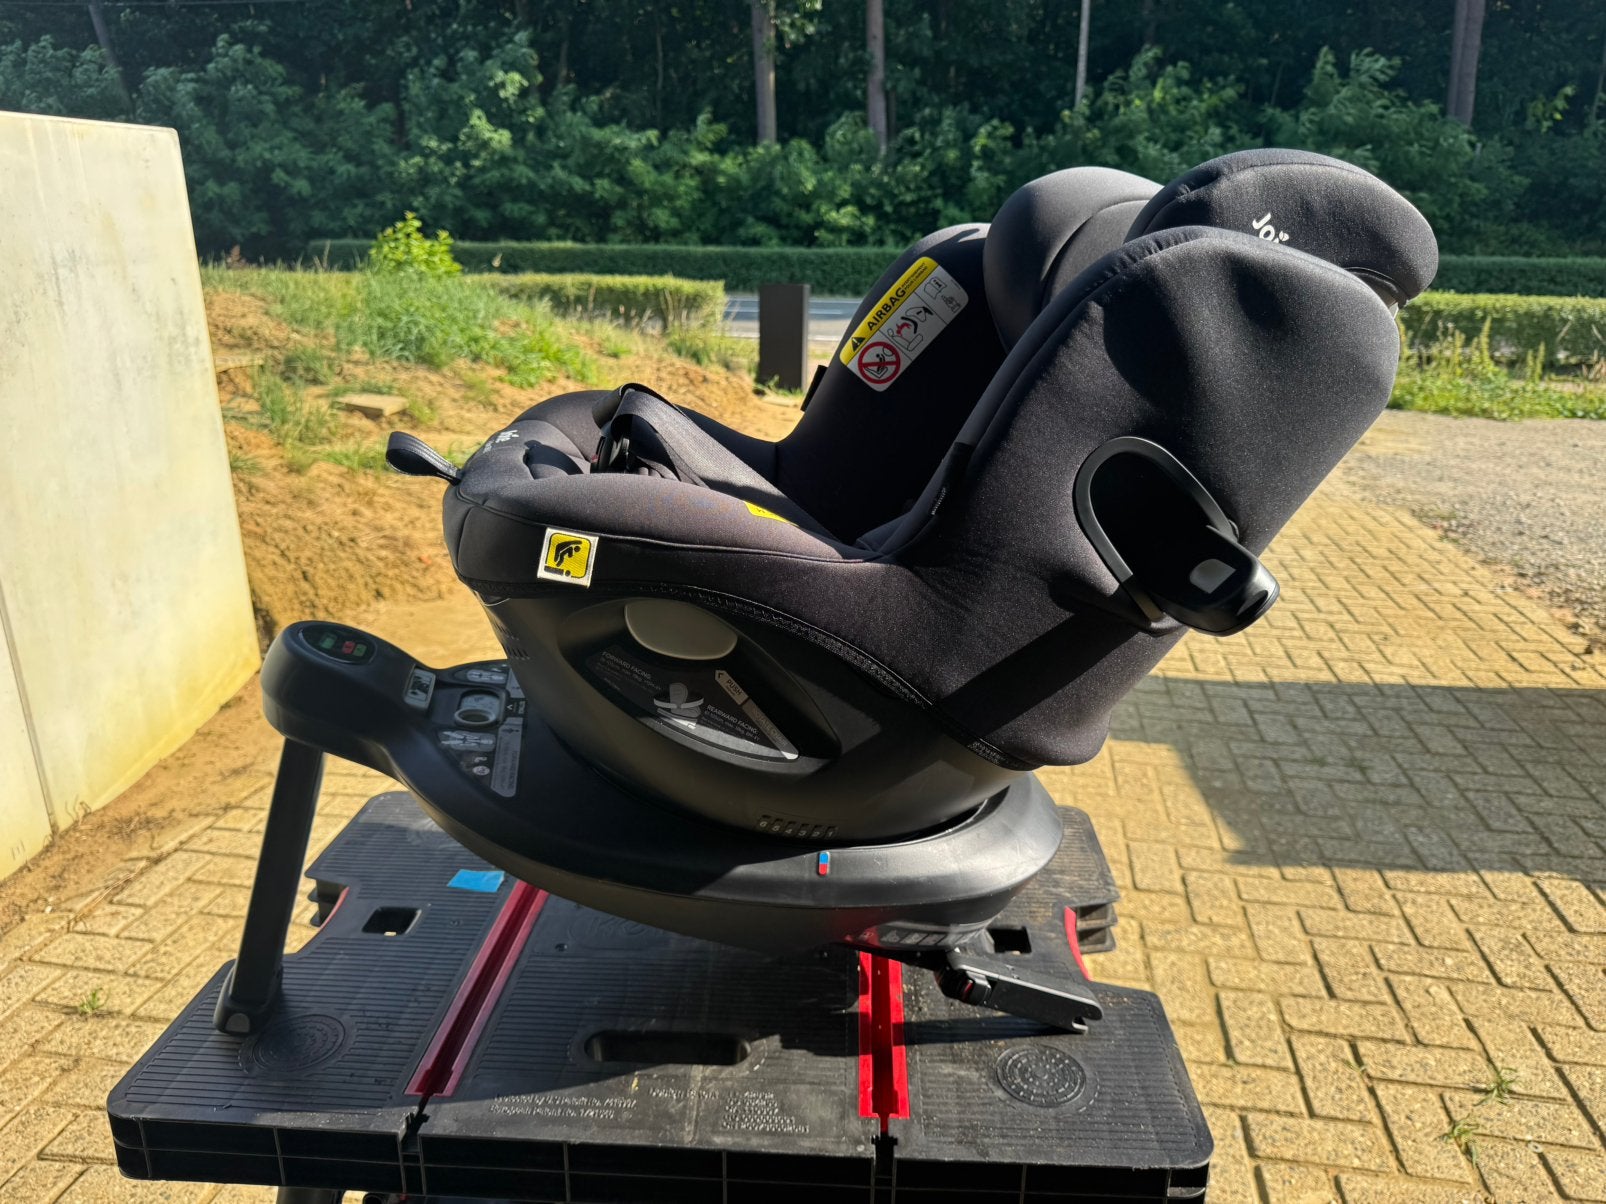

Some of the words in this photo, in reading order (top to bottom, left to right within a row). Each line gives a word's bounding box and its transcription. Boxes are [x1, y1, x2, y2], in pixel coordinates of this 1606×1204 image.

[866, 286, 907, 332] AIRBAG
[725, 679, 743, 696] PUSH
[706, 704, 738, 723] REARWARD
